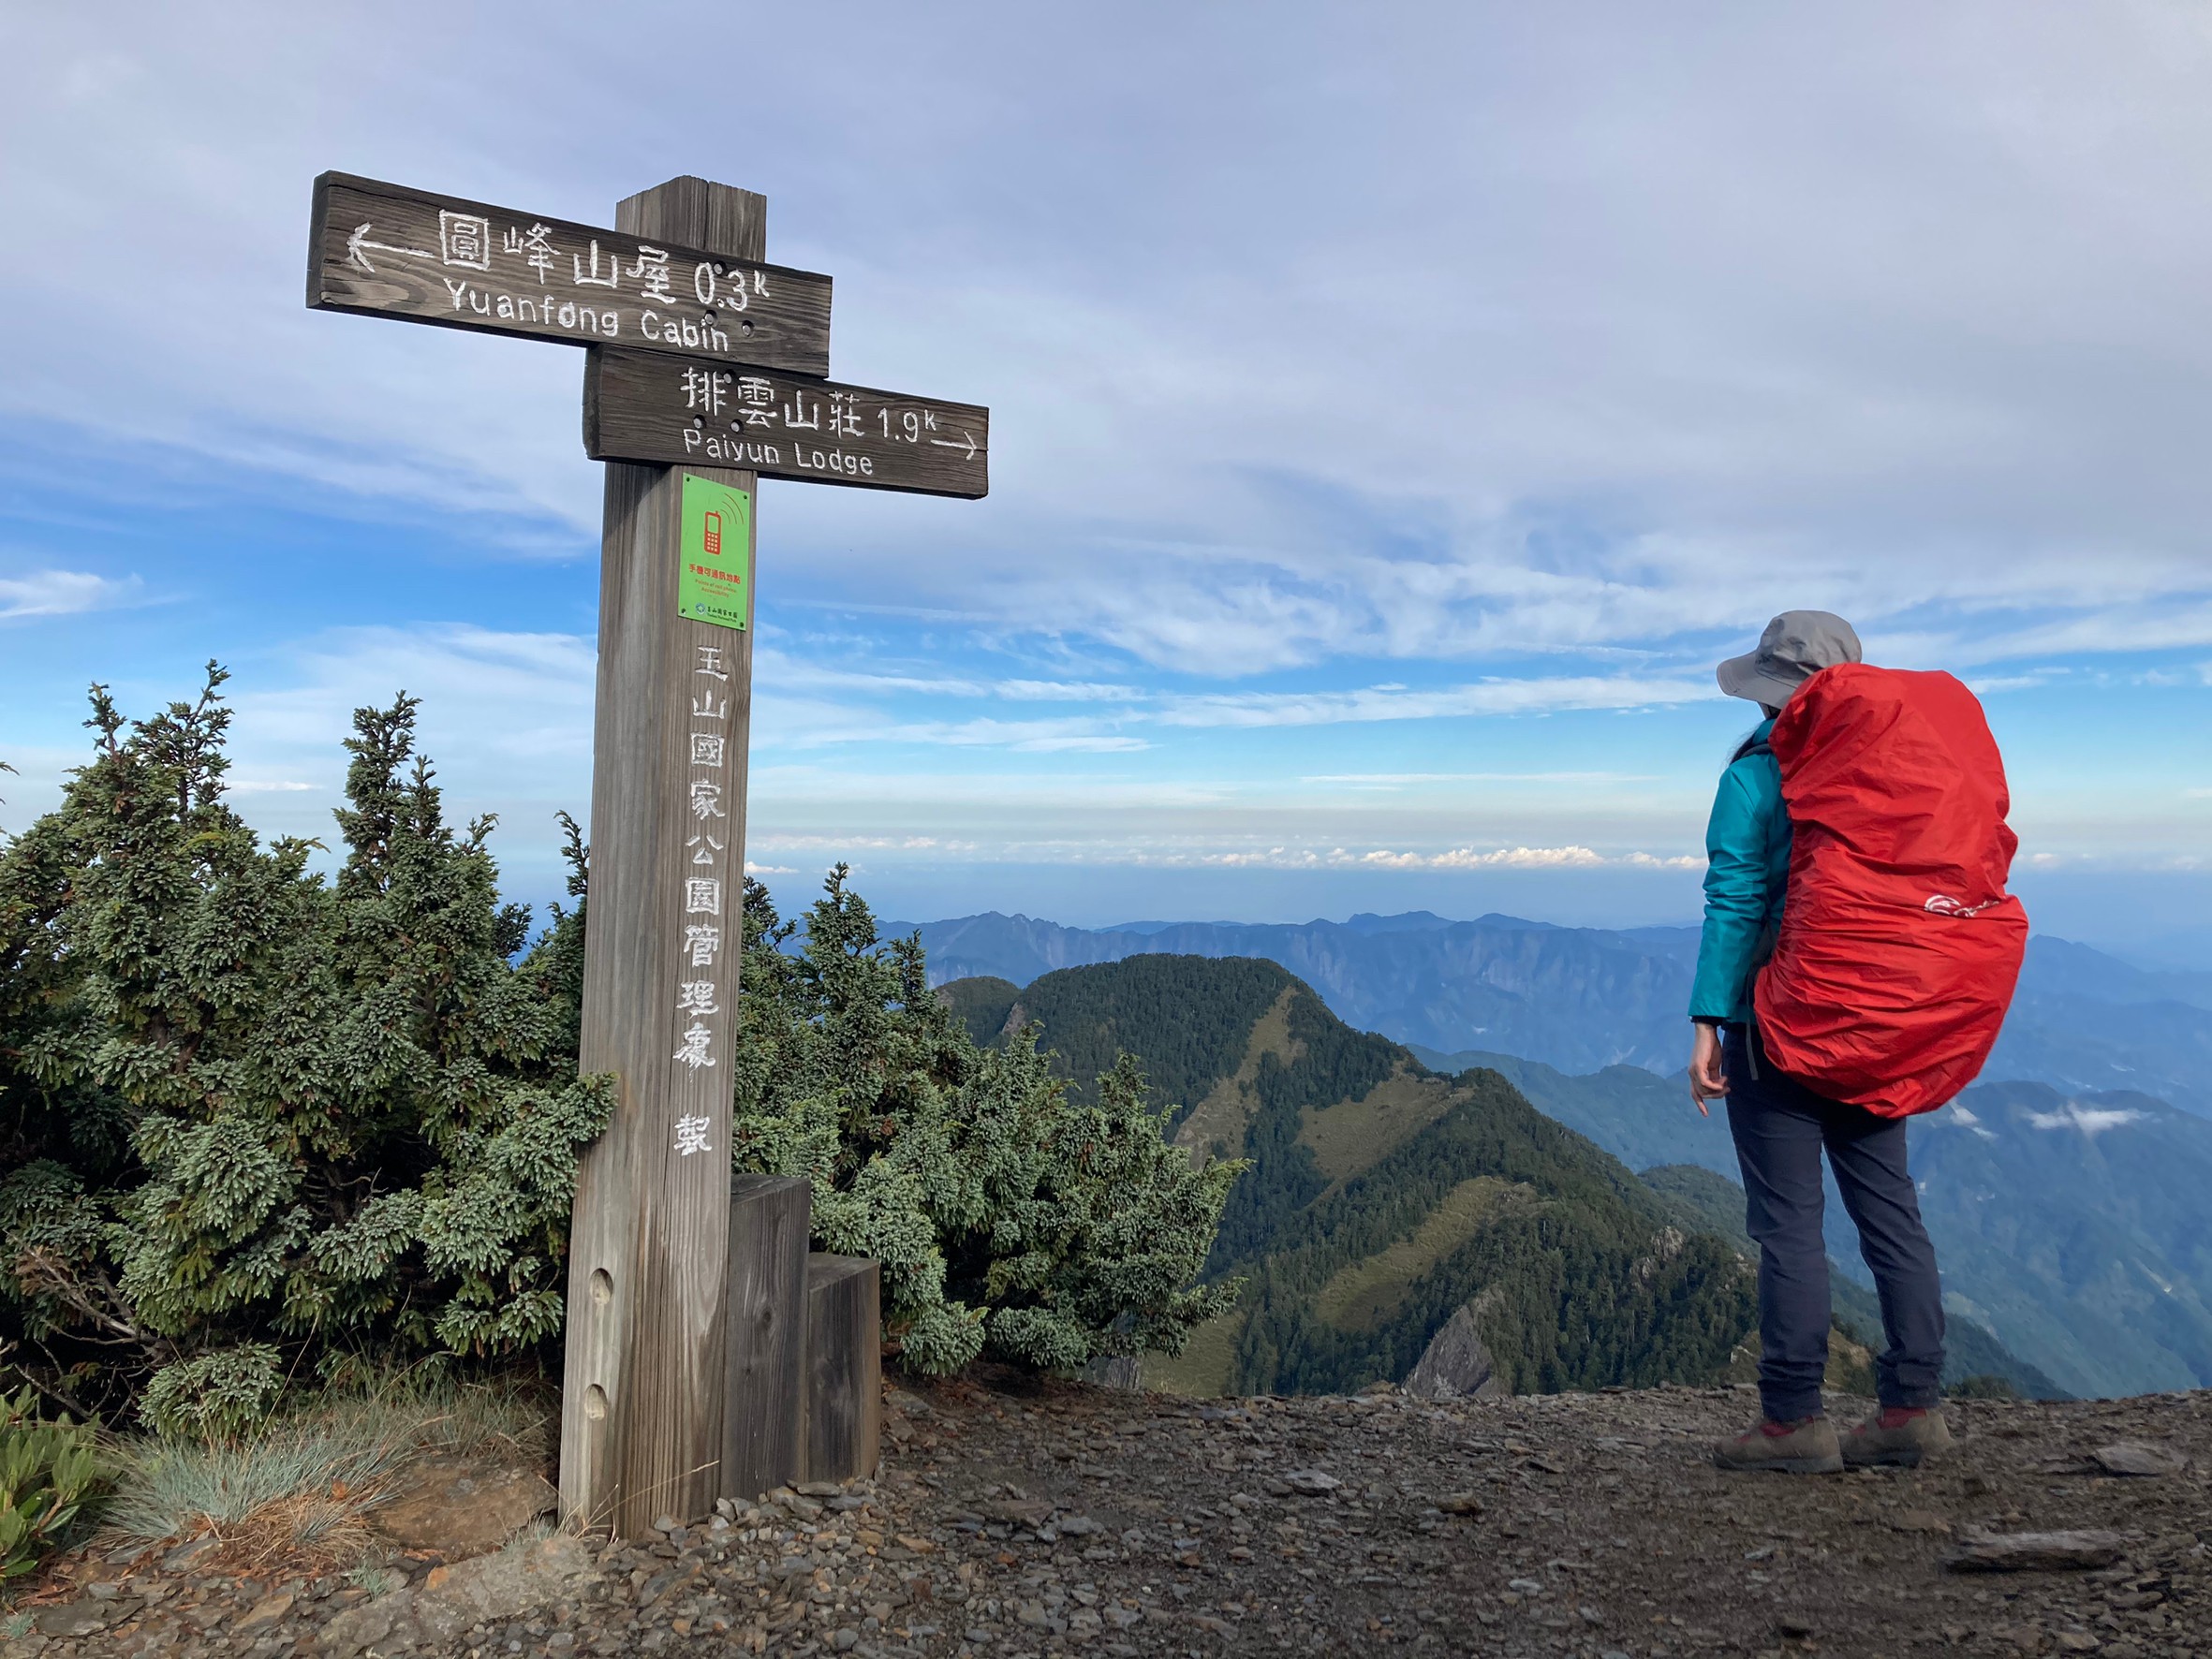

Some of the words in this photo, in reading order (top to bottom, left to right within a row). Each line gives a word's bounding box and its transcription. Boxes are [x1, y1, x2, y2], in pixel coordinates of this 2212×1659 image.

[438, 209, 677, 305] 圓峰山屋
[444, 277, 620, 338] Yuanfong
[641, 310, 729, 352] Cabin
[681, 366, 865, 439] 排雲山莊
[683, 429, 780, 464] Paiyun
[794, 442, 874, 476] Lodge
